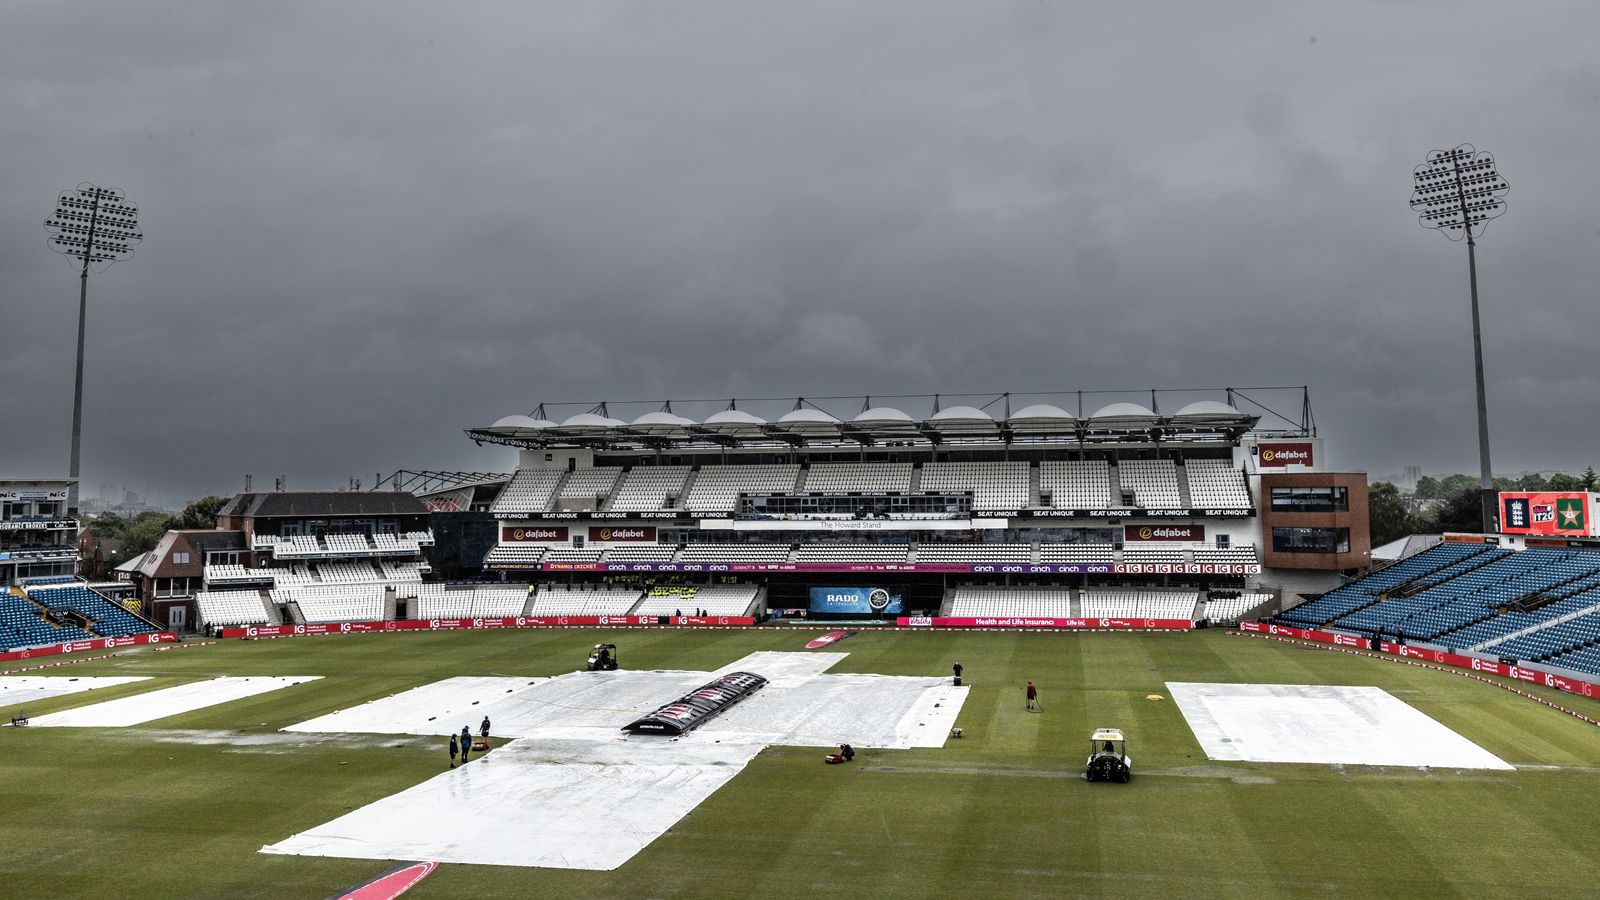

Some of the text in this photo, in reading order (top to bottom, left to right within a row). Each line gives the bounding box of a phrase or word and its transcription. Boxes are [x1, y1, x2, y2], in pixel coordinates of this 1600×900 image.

[1274, 450, 1308, 460] dafabet
[1534, 512, 1554, 522] IT20
[525, 530, 556, 538] dafabet
[612, 529, 644, 538] dafabet
[1154, 528, 1191, 538] dafabet
[294, 625, 305, 633] IG
[1270, 625, 1277, 634] IG
[148, 634, 159, 643] IG
[1302, 630, 1310, 639] IG
[1334, 635, 1342, 644] IG
[62, 643, 71, 653] IG
[105, 638, 115, 648] IG
[1400, 645, 1407, 656] IG
[1434, 651, 1444, 663] IG
[1472, 659, 1480, 670] IG
[1510, 666, 1518, 678] IG
[1545, 673, 1554, 686] IG
[1582, 681, 1591, 696] IG
